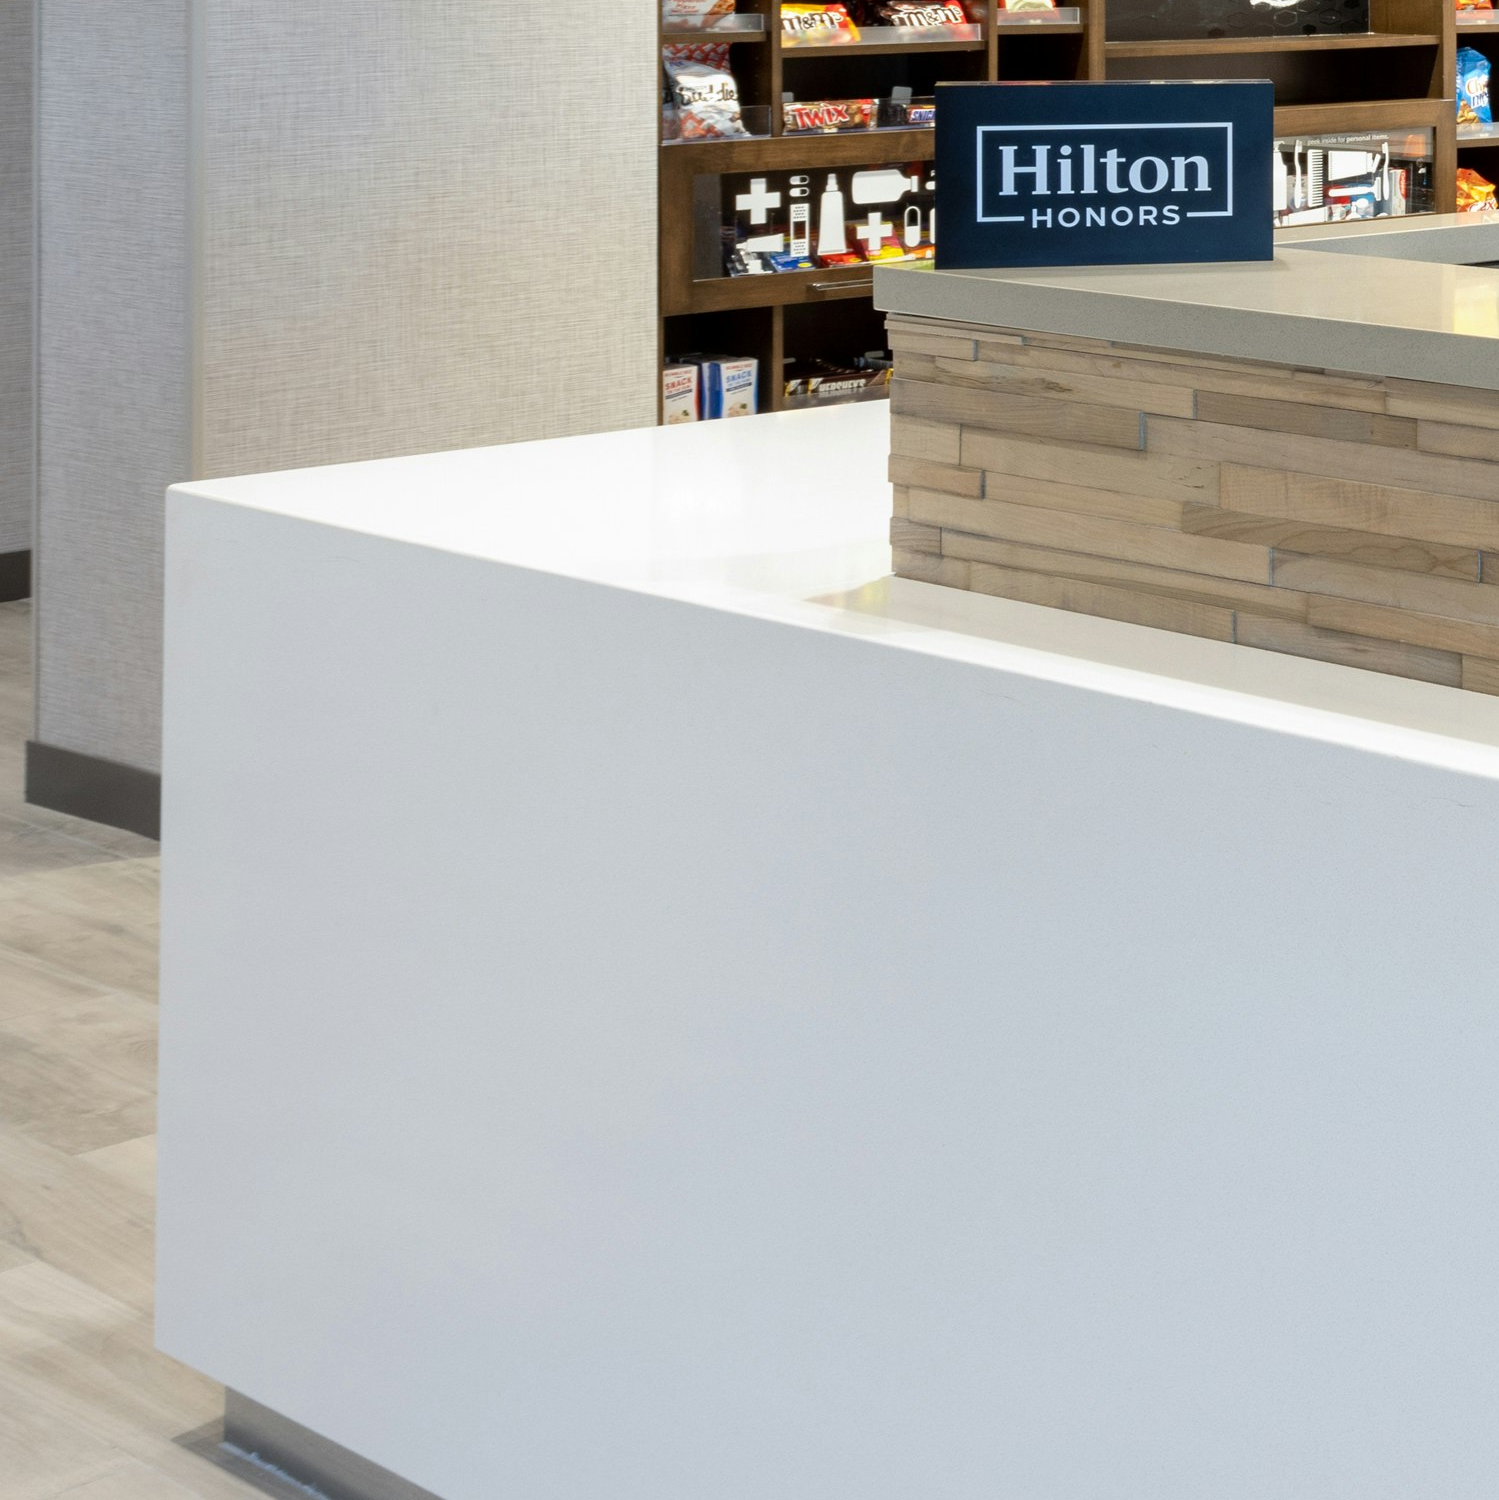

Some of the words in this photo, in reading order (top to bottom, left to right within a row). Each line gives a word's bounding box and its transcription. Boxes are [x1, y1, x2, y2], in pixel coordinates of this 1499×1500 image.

[792, 104, 850, 130] TWIX
[1346, 135, 1371, 143] personal
[998, 144, 1212, 196] Hilton
[1032, 205, 1181, 229] HONORS
[665, 378, 692, 391] SNACK
[726, 370, 752, 383] SNACK
